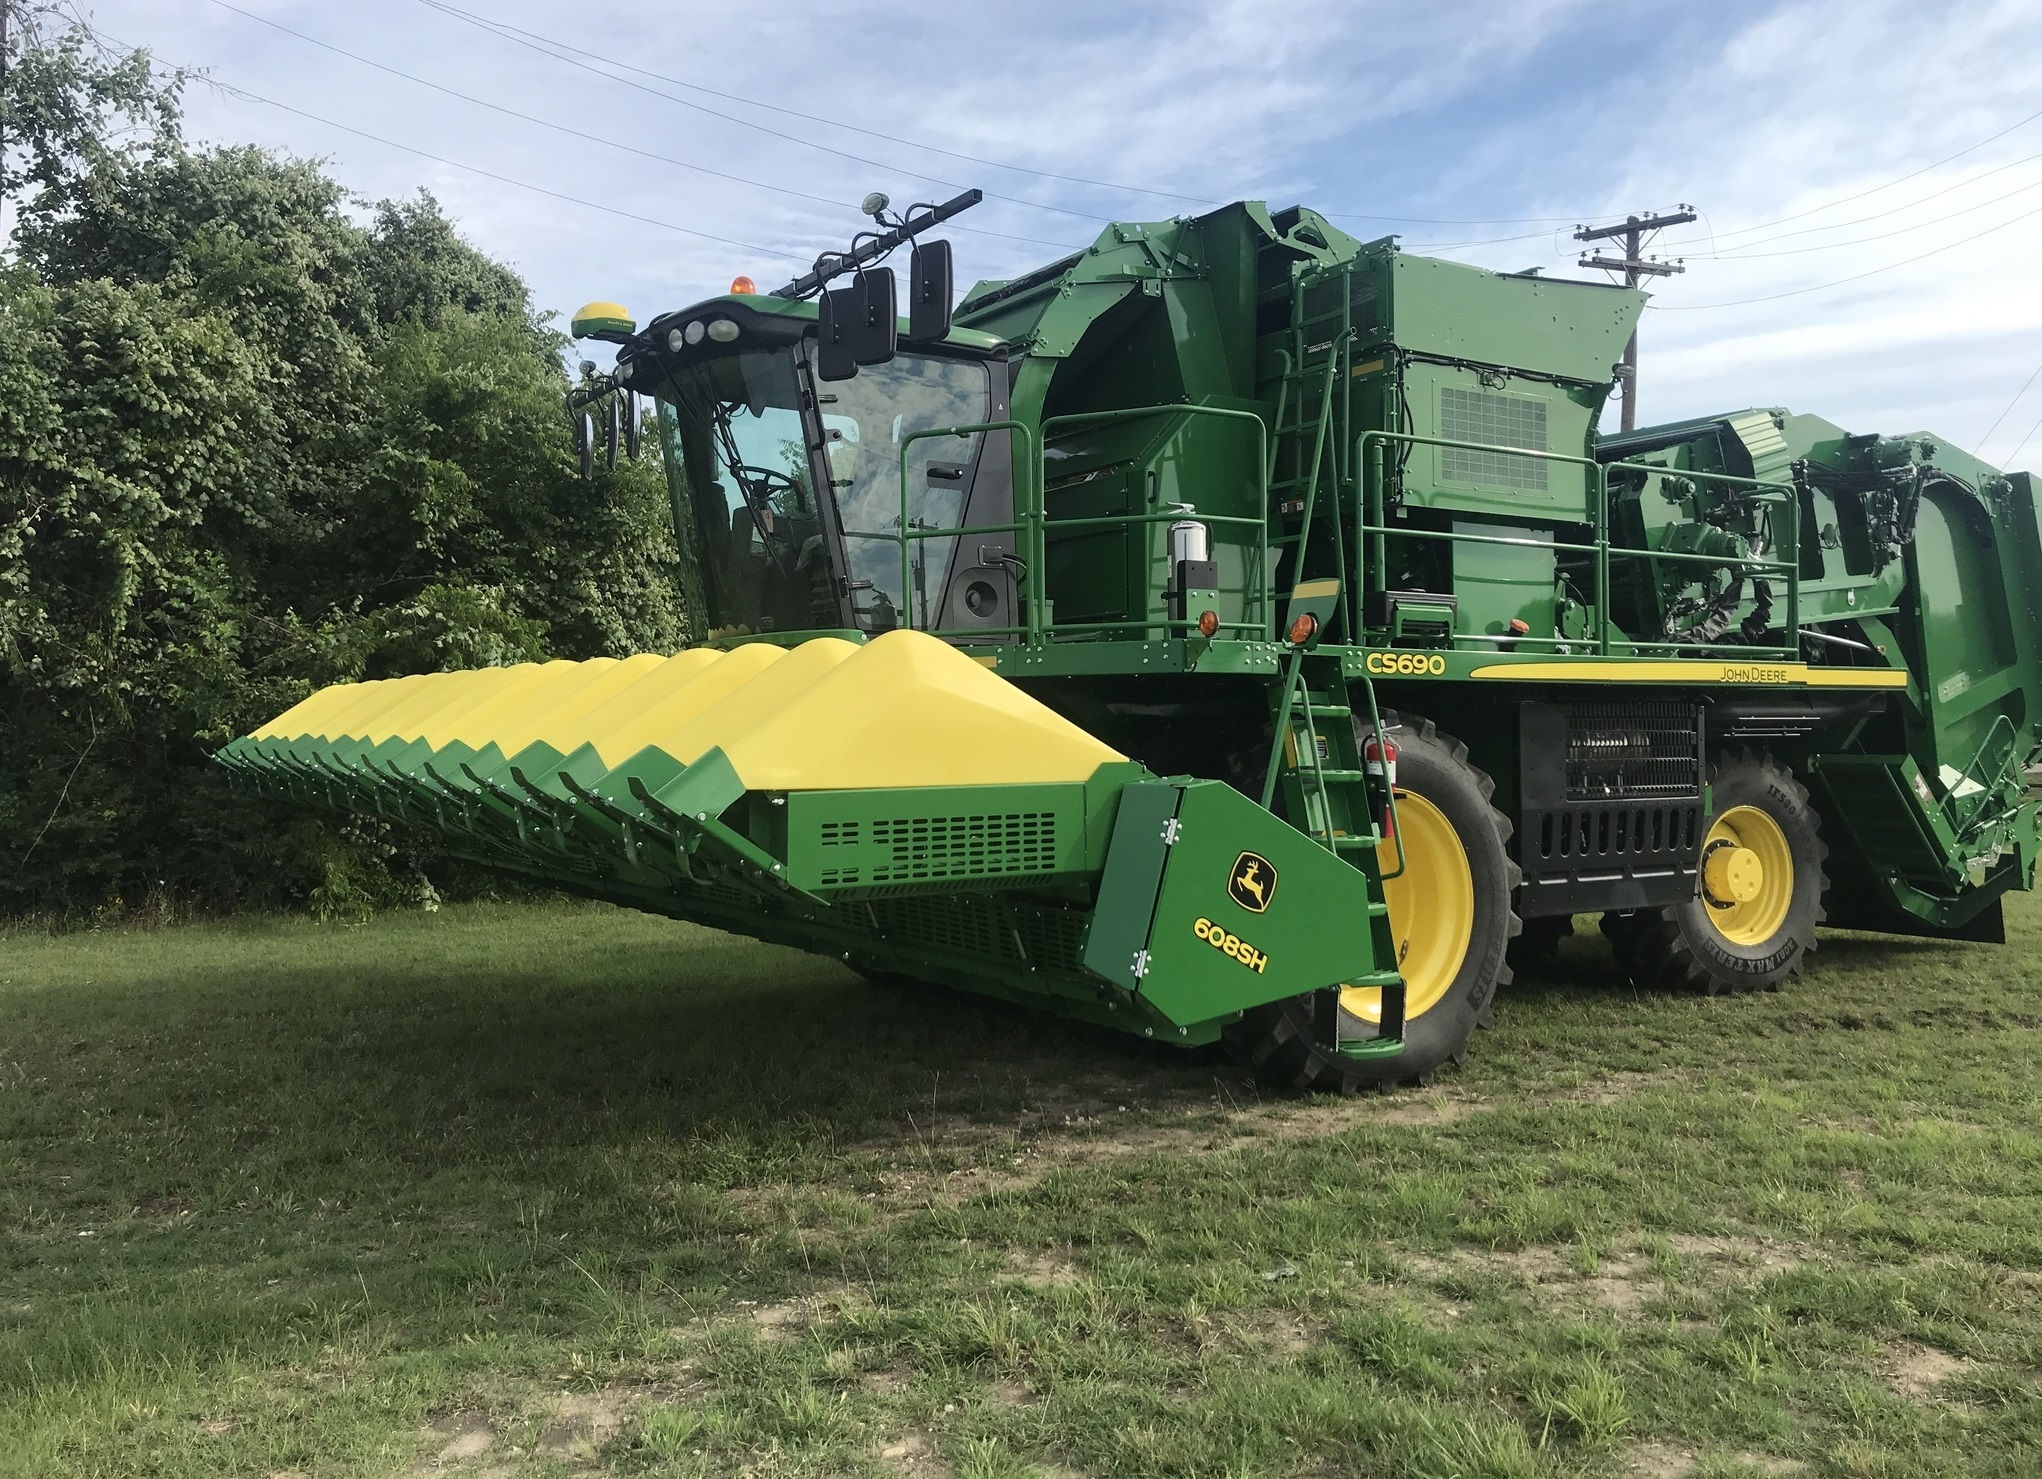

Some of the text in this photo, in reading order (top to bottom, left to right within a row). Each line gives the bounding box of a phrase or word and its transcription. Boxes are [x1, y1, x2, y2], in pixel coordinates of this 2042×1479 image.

[1366, 652, 1446, 675] CS690
[1720, 667, 1787, 681] JOHN DEERE
[1194, 917, 1268, 974] 608SH
